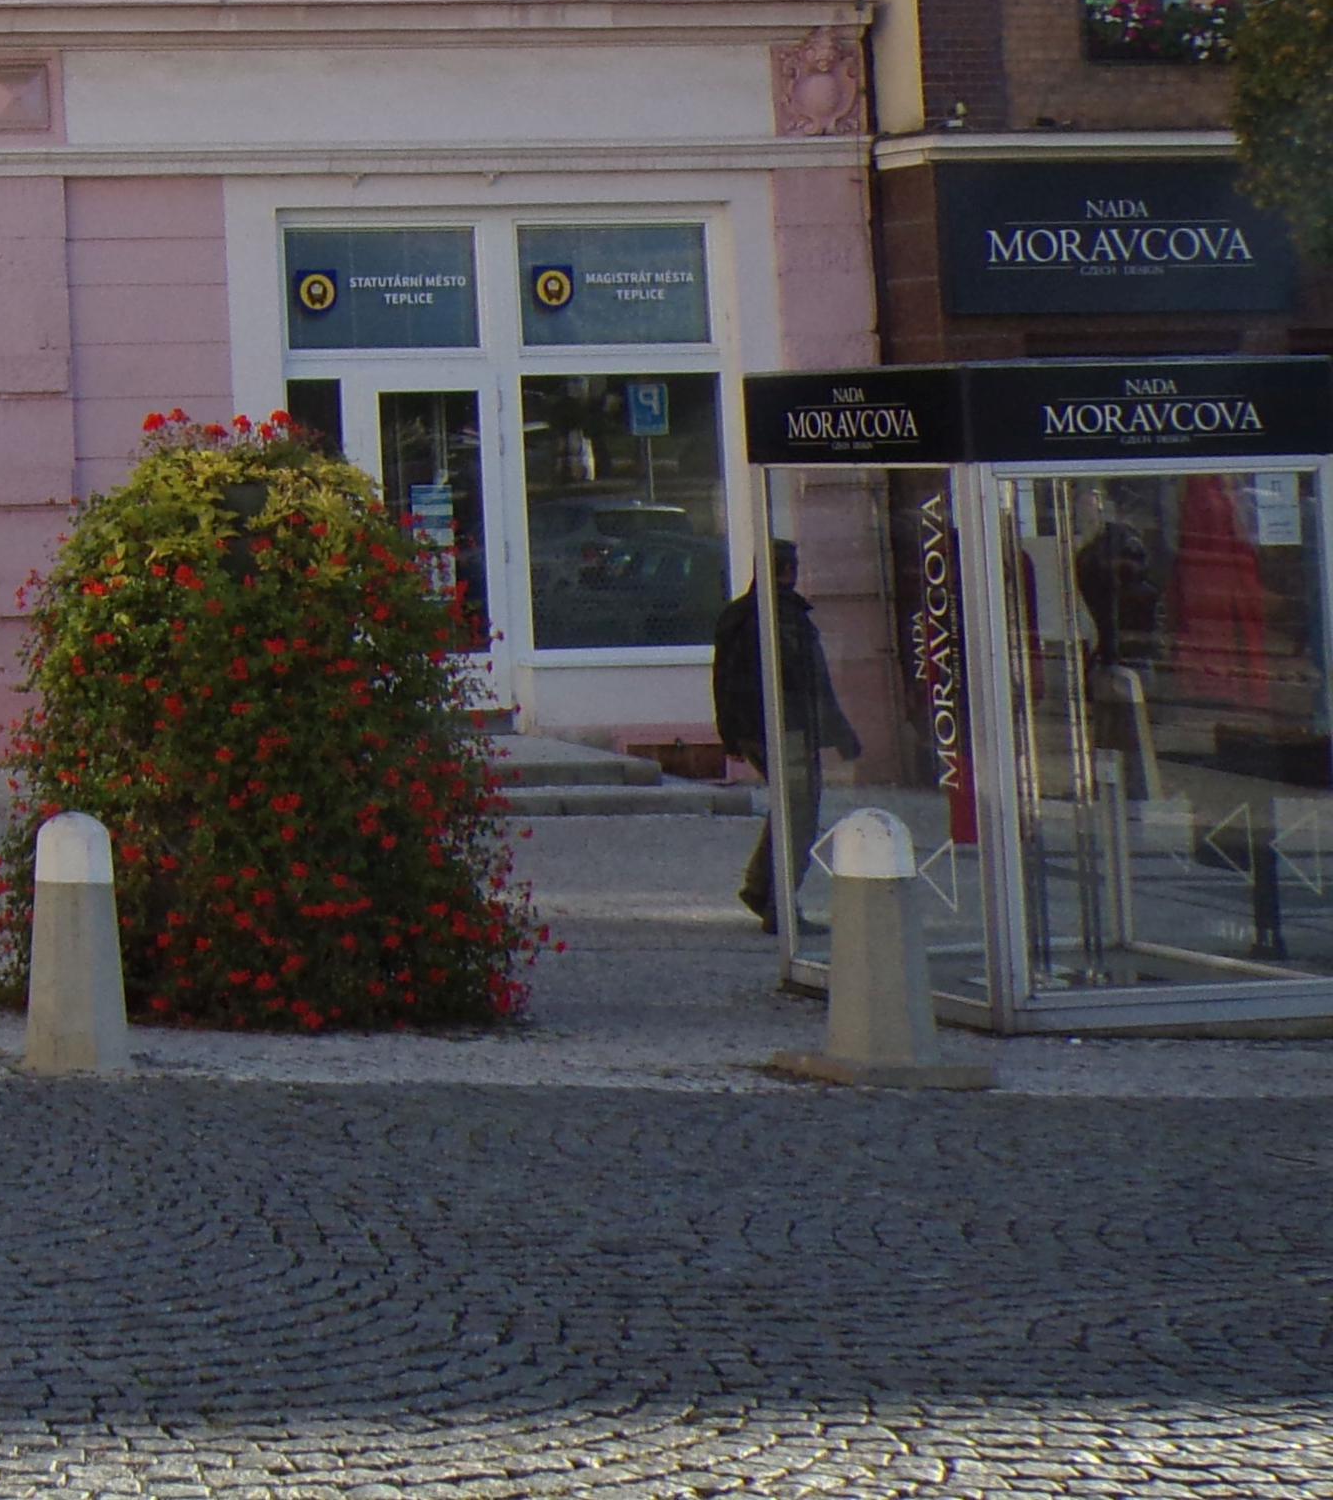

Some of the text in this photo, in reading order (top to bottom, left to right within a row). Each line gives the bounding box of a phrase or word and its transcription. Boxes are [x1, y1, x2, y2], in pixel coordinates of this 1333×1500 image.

[1086, 199, 1149, 219] NADA
[986, 227, 1253, 263] MORAVCOVA
[349, 273, 423, 288] STATUTÁRNÍ
[585, 269, 652, 284] MAGISTRÁT
[384, 292, 434, 305] TEPLICE
[616, 288, 666, 301] TEPLICE
[833, 386, 865, 403] NADA
[1125, 378, 1178, 396] NADA
[787, 409, 919, 439] MORAVCOVA
[1044, 401, 1264, 434] MORAVCOVA
[912, 610, 927, 680] NADA
[921, 494, 959, 790] MORAVCOVA
